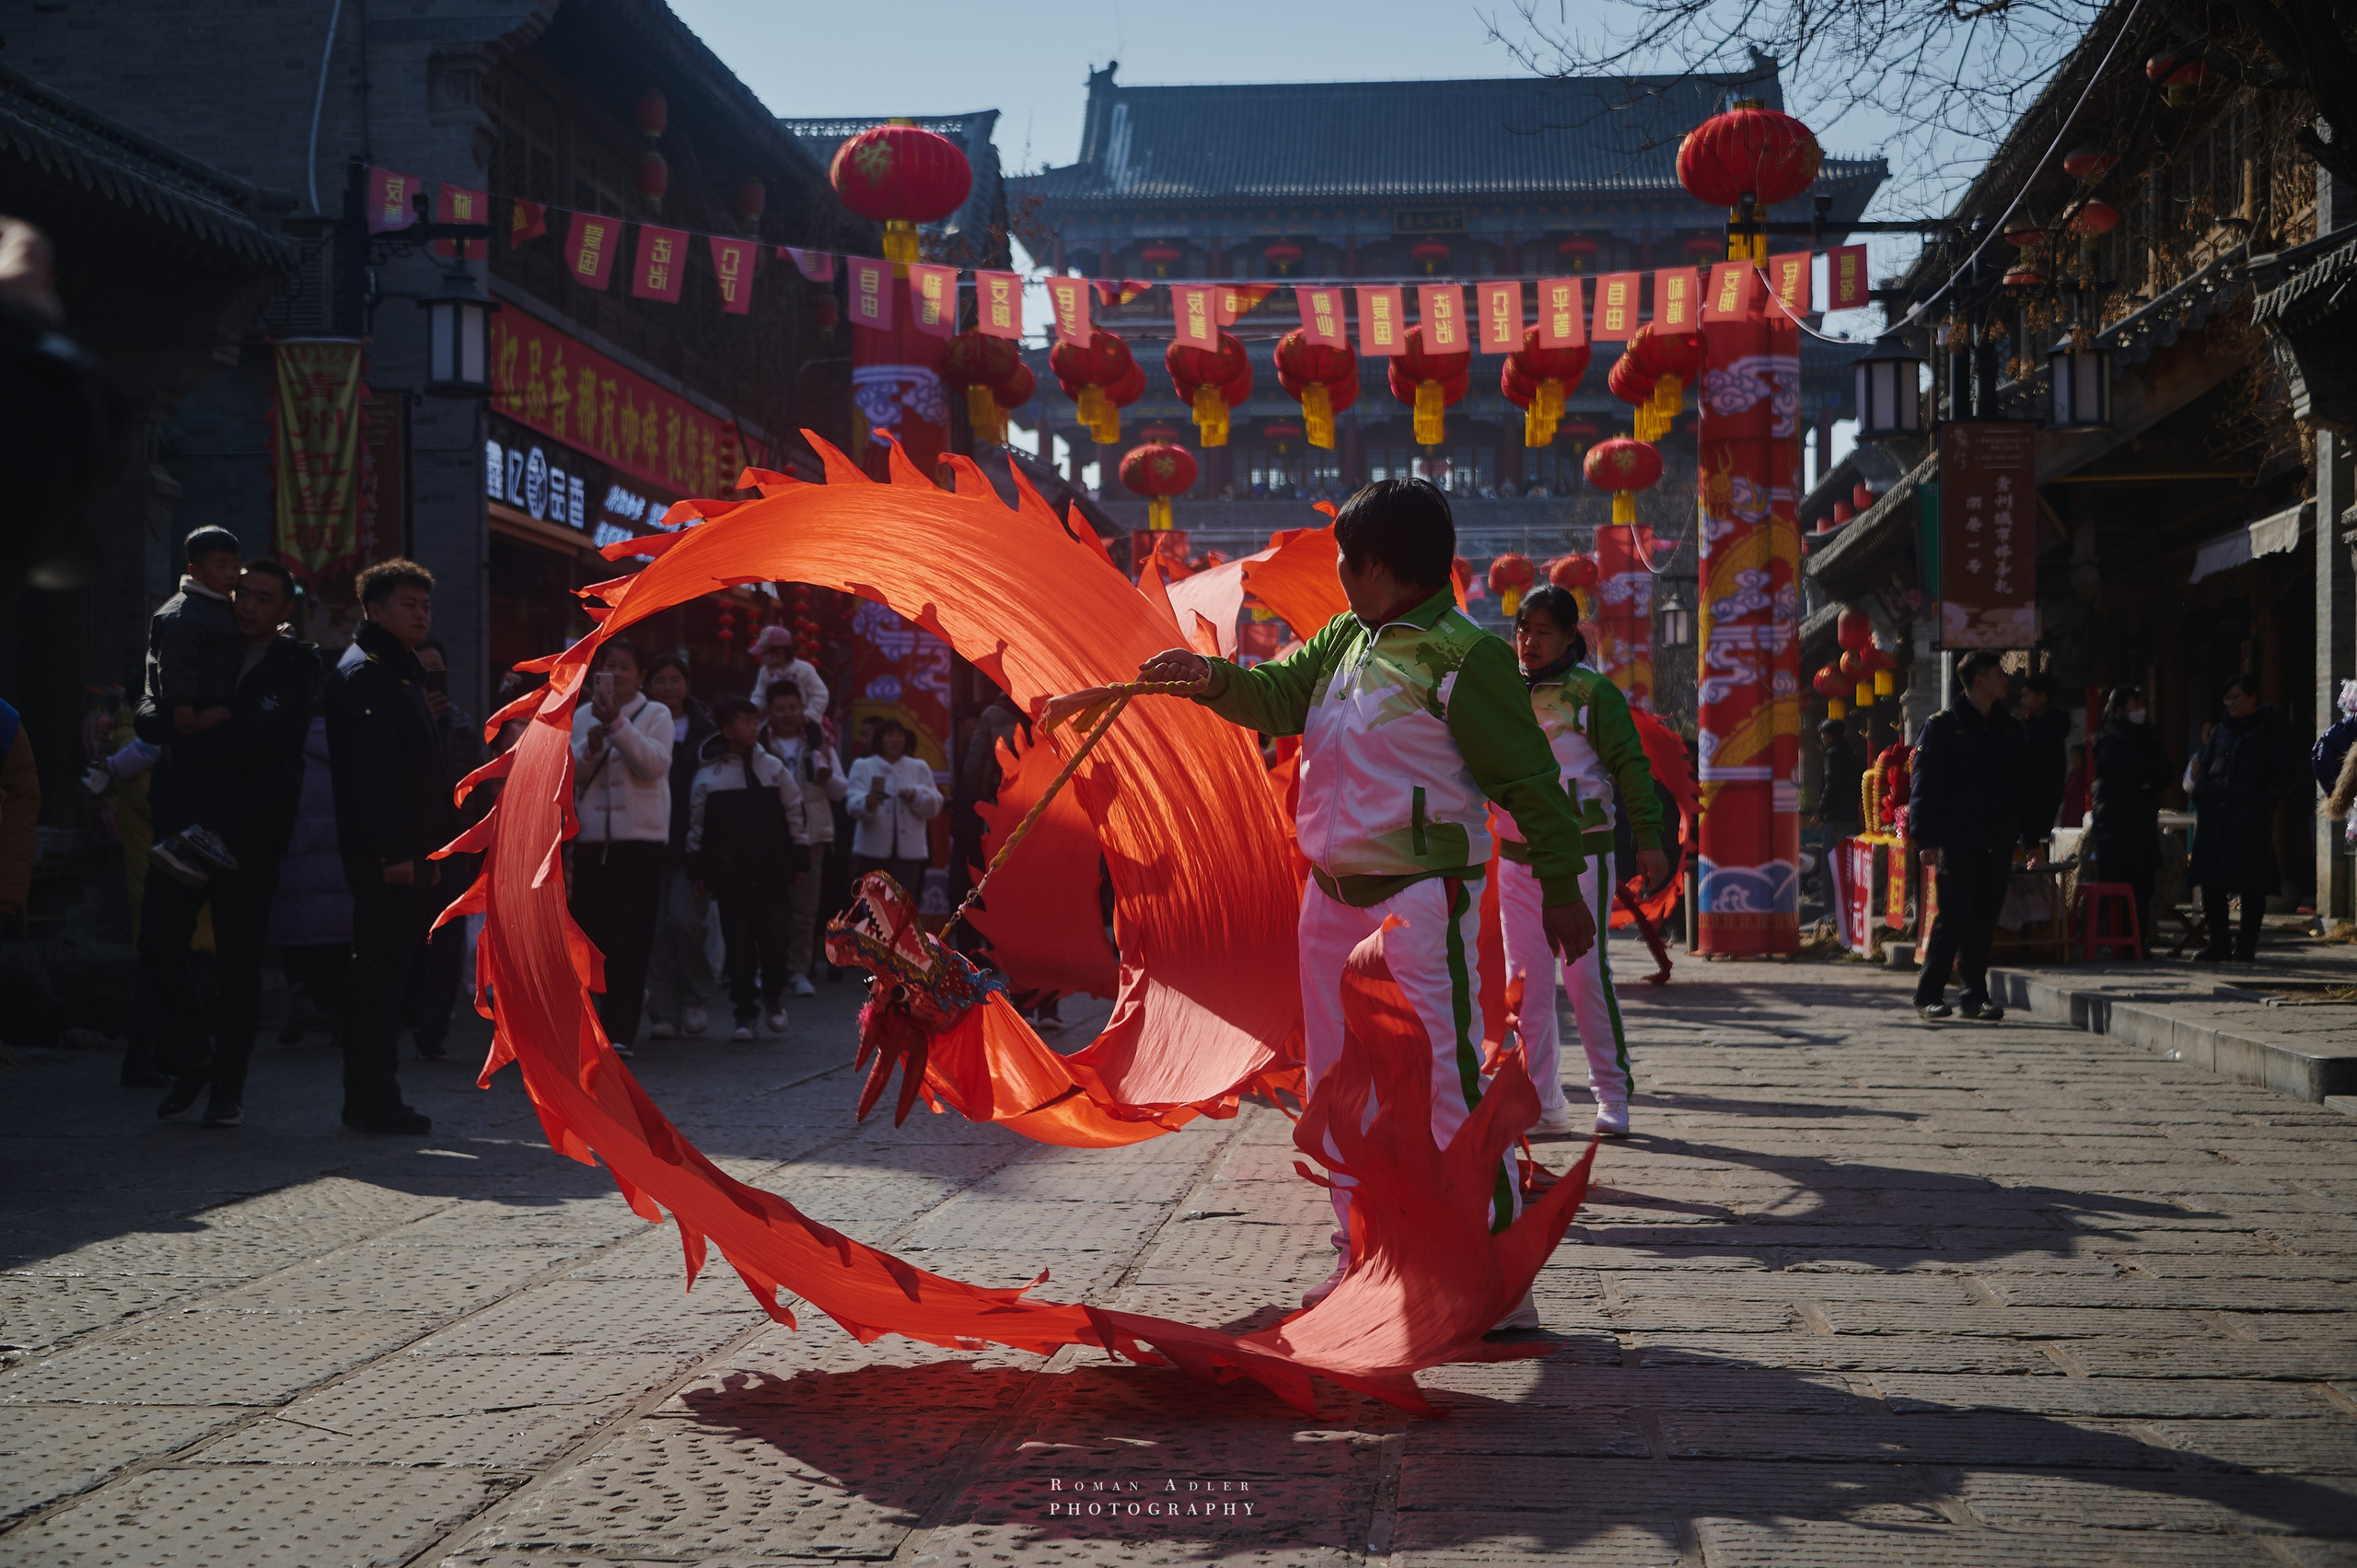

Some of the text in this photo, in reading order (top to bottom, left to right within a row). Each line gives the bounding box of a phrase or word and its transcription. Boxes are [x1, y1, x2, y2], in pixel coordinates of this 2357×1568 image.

[285, 370, 352, 556] 青州红丝砚
[549, 466, 586, 530] 品香
